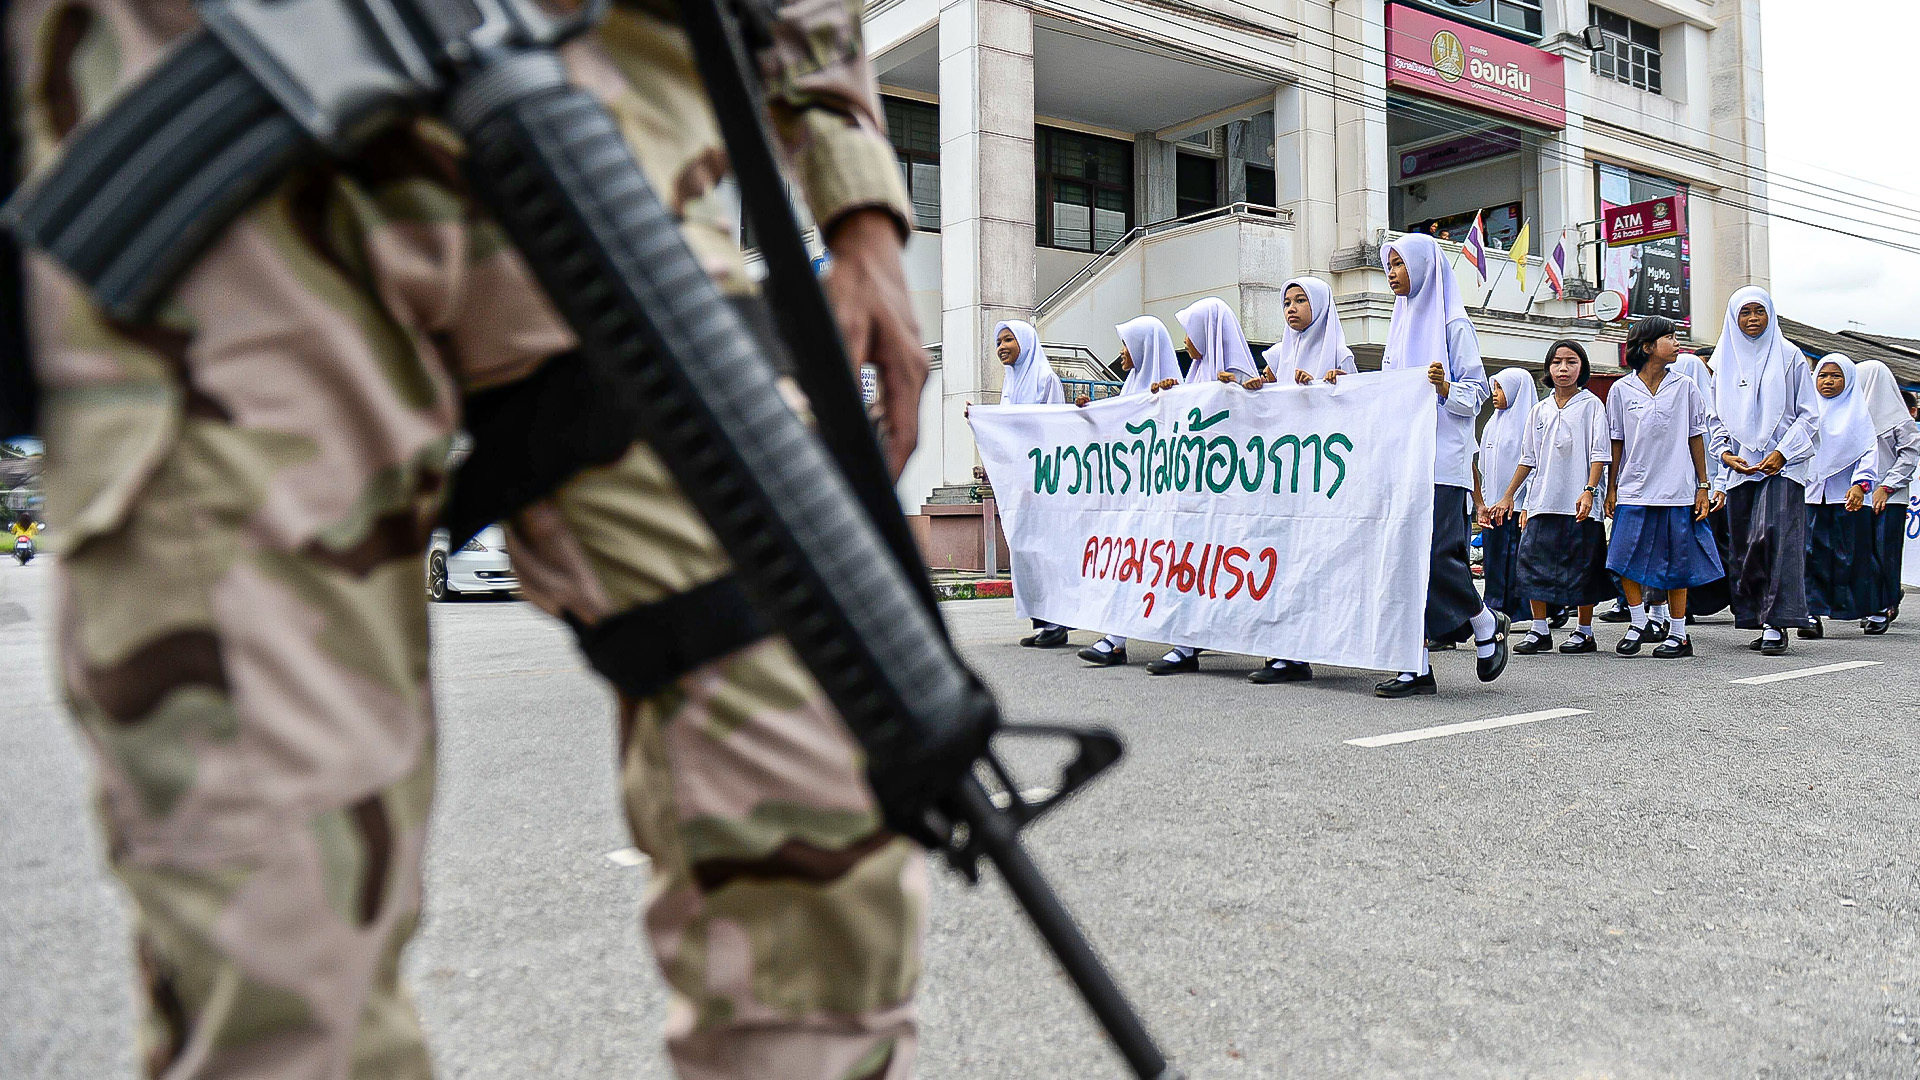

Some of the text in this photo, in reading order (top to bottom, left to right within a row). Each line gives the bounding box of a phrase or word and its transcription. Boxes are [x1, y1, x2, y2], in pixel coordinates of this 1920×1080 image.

[1469, 57, 1531, 93] ออมสิน
[1613, 212, 1643, 231] ATM
[1612, 231, 1622, 241] 24
[1622, 229, 1644, 239] hours
[1647, 266, 1671, 281] MyMo
[1664, 284, 1680, 295] Card
[1028, 406, 1353, 499] พวกเราไม่ต้องการ
[1081, 535, 1278, 618] ความรุนแรง
